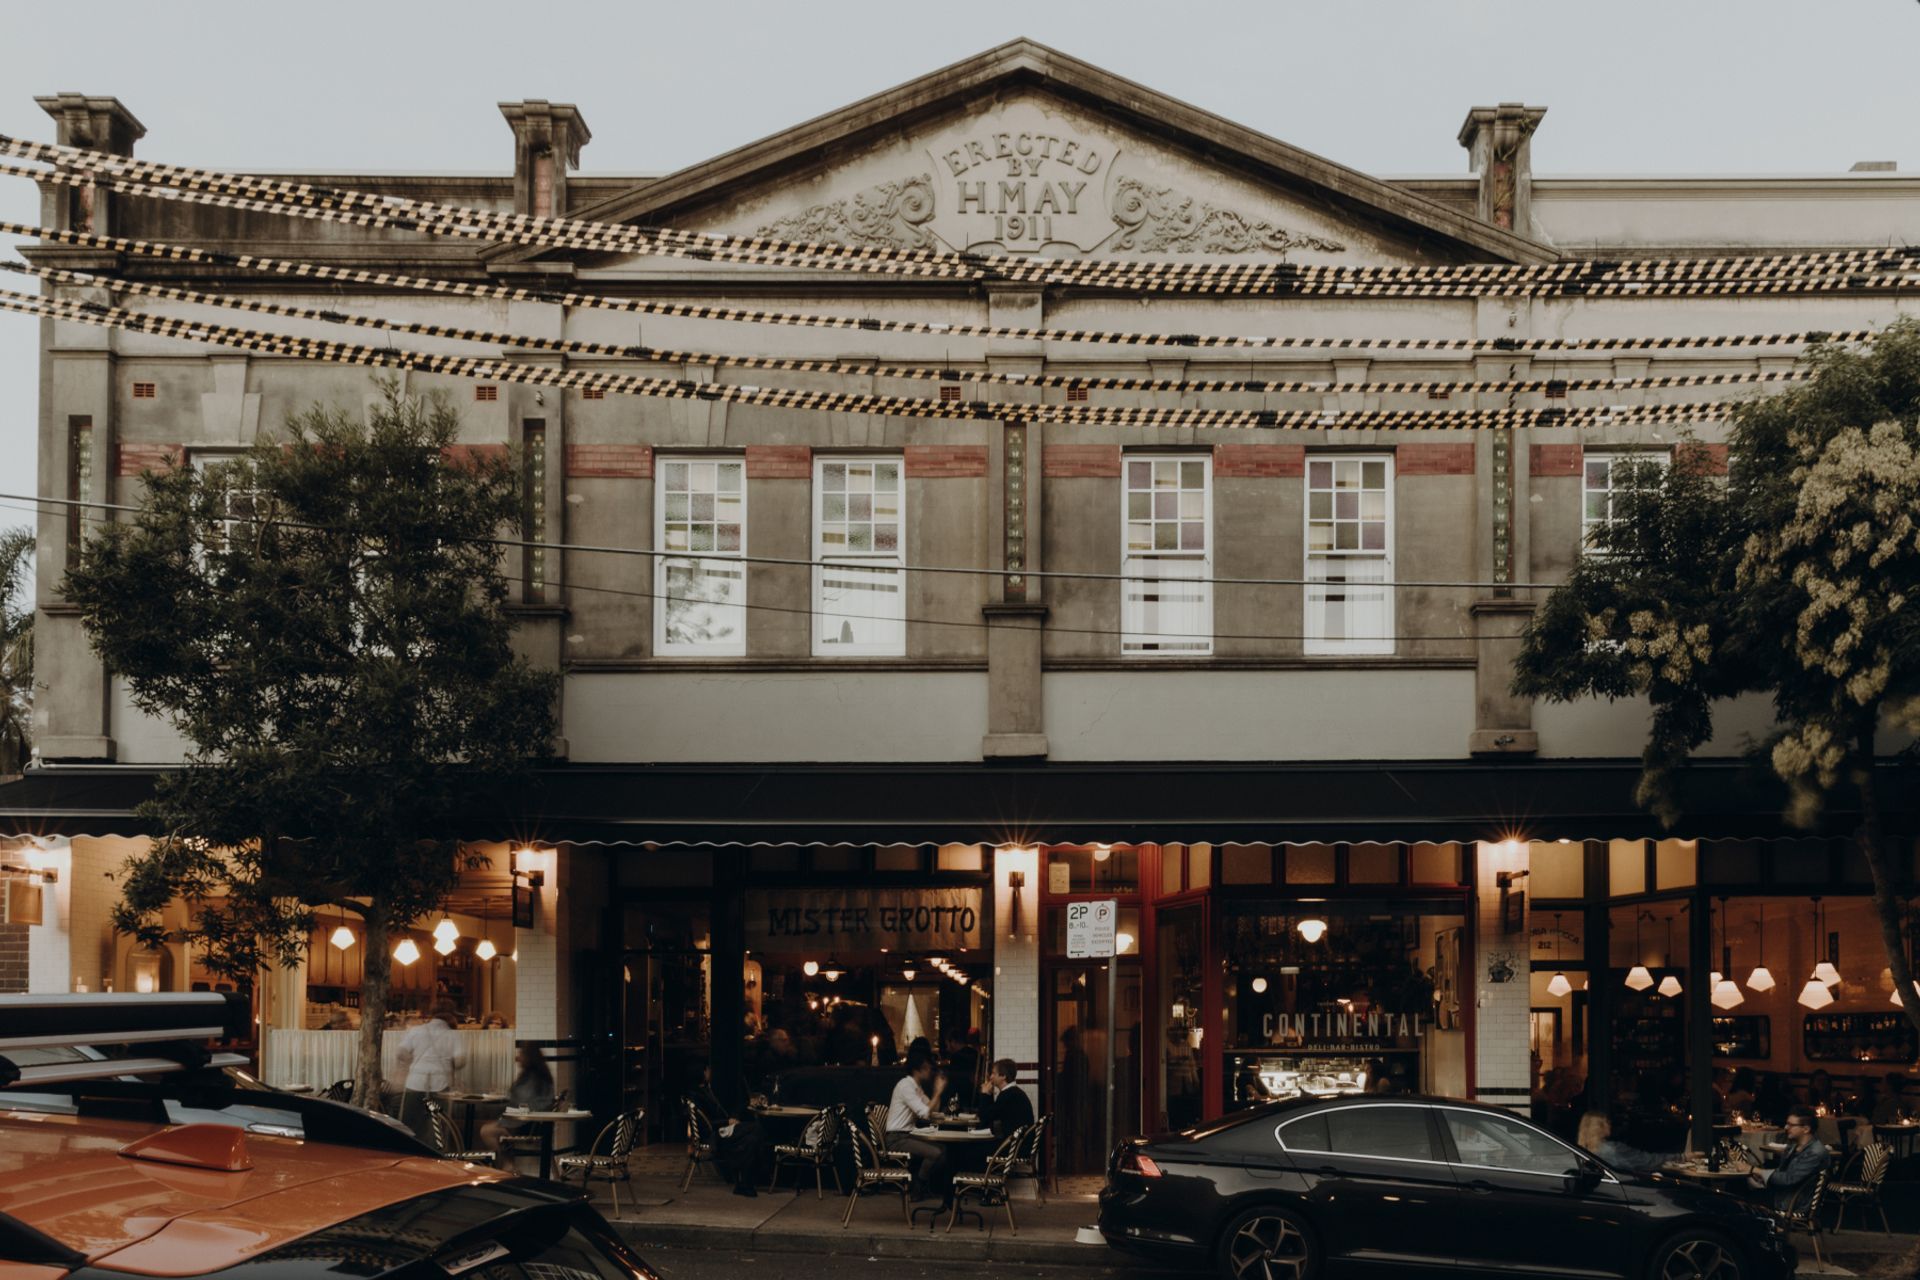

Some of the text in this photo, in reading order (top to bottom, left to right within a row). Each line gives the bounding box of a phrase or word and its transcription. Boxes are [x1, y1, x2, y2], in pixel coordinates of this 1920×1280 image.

[942, 132, 1102, 177] ERECTED
[1007, 158, 1043, 177] BY
[994, 215, 1053, 241] 1911
[768, 905, 976, 937] MISTER GROTTO
[1070, 906, 1089, 920] 2P
[1263, 1012, 1425, 1038] CONTINENTAL
